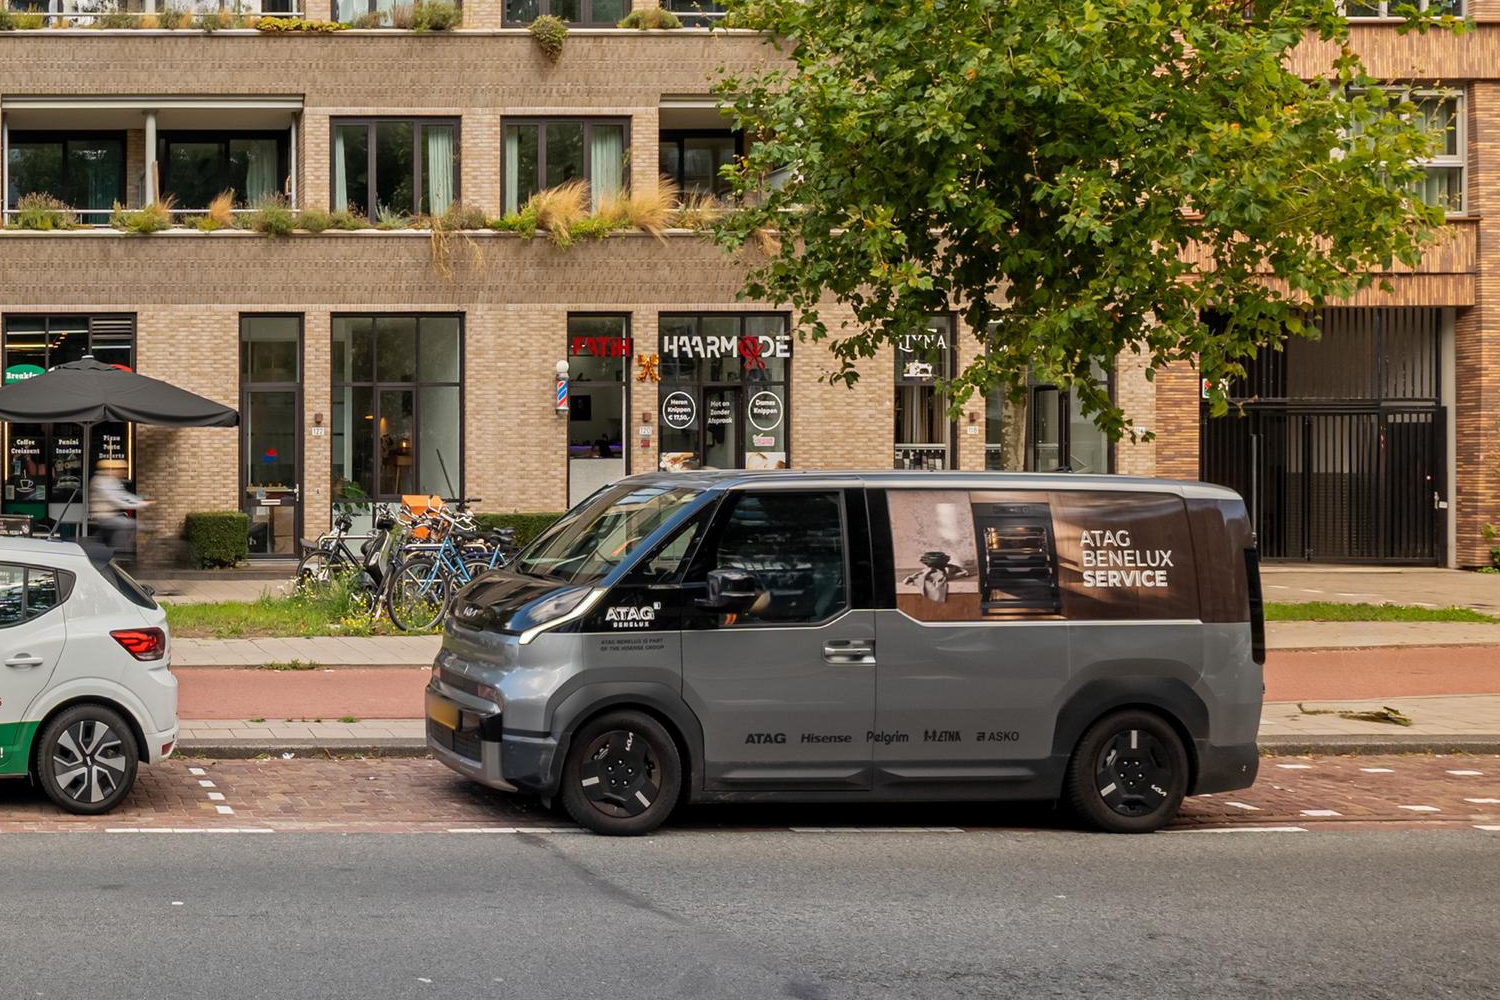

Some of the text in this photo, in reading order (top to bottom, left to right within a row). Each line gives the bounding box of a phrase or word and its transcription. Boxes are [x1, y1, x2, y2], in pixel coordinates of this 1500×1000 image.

[667, 406, 691, 414] Knippen
[753, 407, 778, 415] Knippen
[707, 416, 733, 425] Afspraak
[10, 447, 40, 455] Croissant
[1080, 529, 1131, 547] ATAG
[1082, 550, 1174, 567] BENELUX
[1082, 569, 1169, 587] SERVICE
[605, 606, 655, 621] ATAG
[745, 733, 787, 745] ATAG
[800, 732, 852, 744] Hisense
[866, 730, 909, 745] Pelgrim
[987, 731, 1019, 742] ASKO
